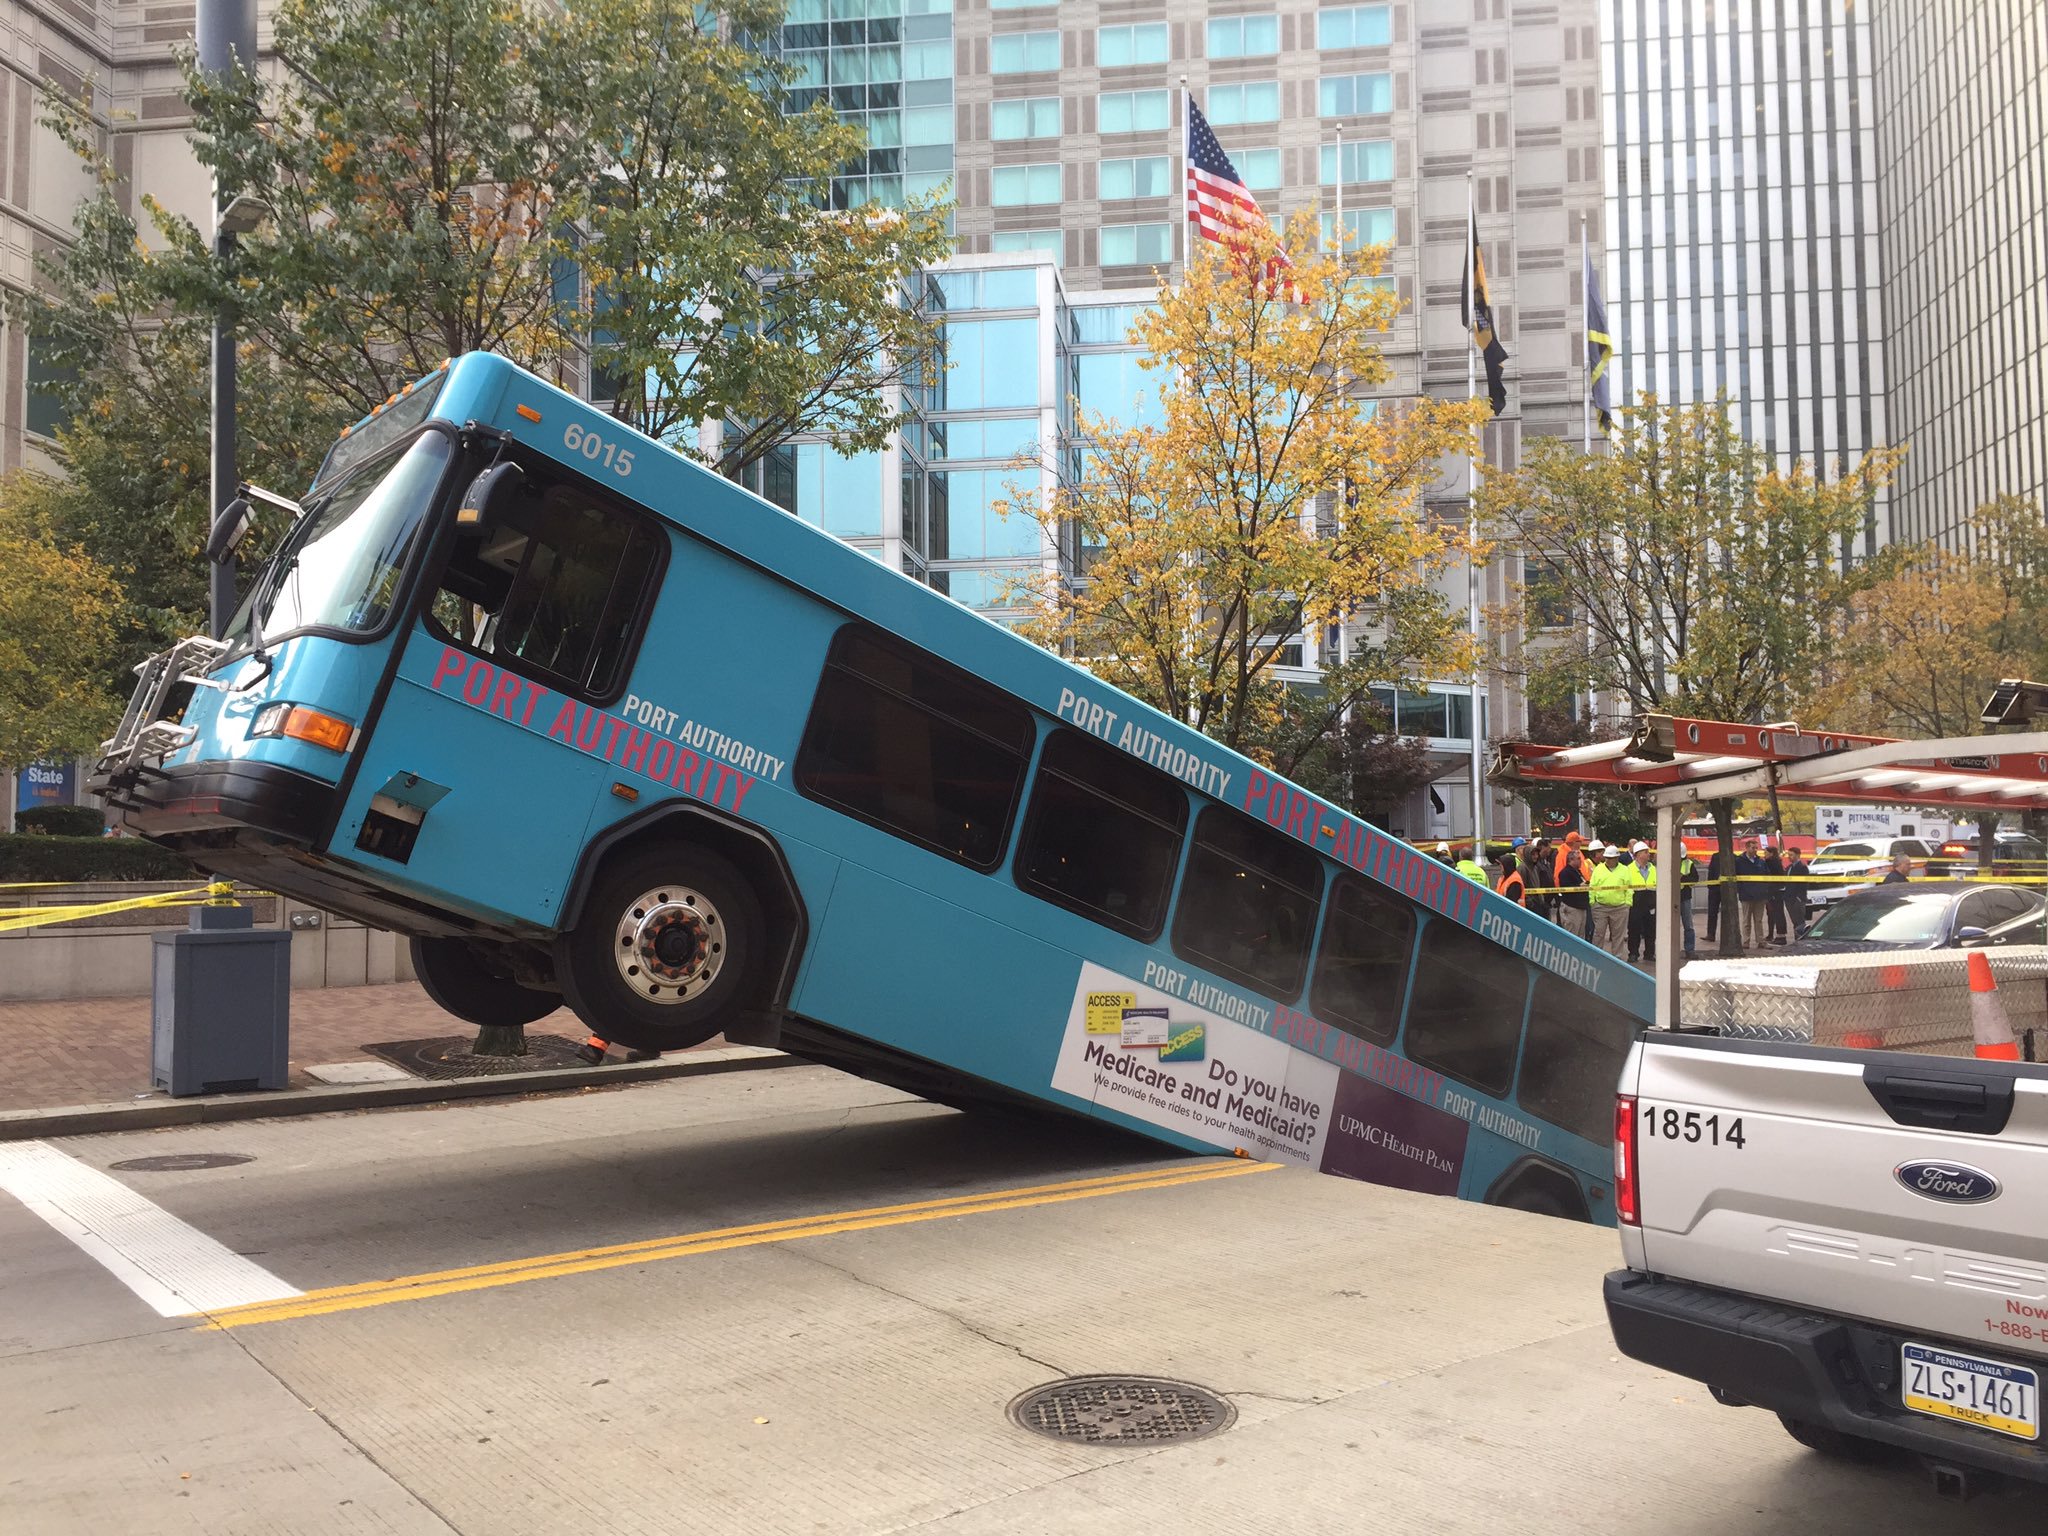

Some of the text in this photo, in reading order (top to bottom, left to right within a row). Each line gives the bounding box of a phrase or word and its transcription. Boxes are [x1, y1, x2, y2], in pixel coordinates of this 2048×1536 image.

[564, 423, 635, 477] 6015
[432, 647, 756, 813] PORT AUTHORITY
[622, 695, 785, 780] PORT AUTHORITY
[1057, 688, 1231, 799] PORT AUTHORITY
[28, 767, 64, 785] State
[1848, 813, 1890, 826] PITTSBURGH
[1245, 768, 1483, 929] PORT AUTHORITY
[1479, 909, 1602, 990] PORT AUTHORITY
[1088, 995, 1121, 1007] ACCESS
[1144, 960, 1270, 1028] PORT AUTHORITY
[1160, 1025, 1203, 1058] ACCESS
[1271, 1003, 1445, 1105] PORT AUTHORITY
[1084, 1040, 1317, 1145] Medicare and Medicaid?
[1208, 1058, 1321, 1120] Do you have
[1093, 1073, 1311, 1162] We provide free rides to your health appointments
[1338, 1114, 1382, 1146] UPMC
[1443, 1090, 1542, 1147] PORT AUTHORITY
[1643, 1106, 1746, 1150] 18514
[1917, 1167, 1974, 1196] Ford
[2006, 1299, 2048, 1320] Now
[1935, 1355, 2002, 1377] PENNSYLVANIA
[1949, 1405, 1990, 1423] TRUCK
